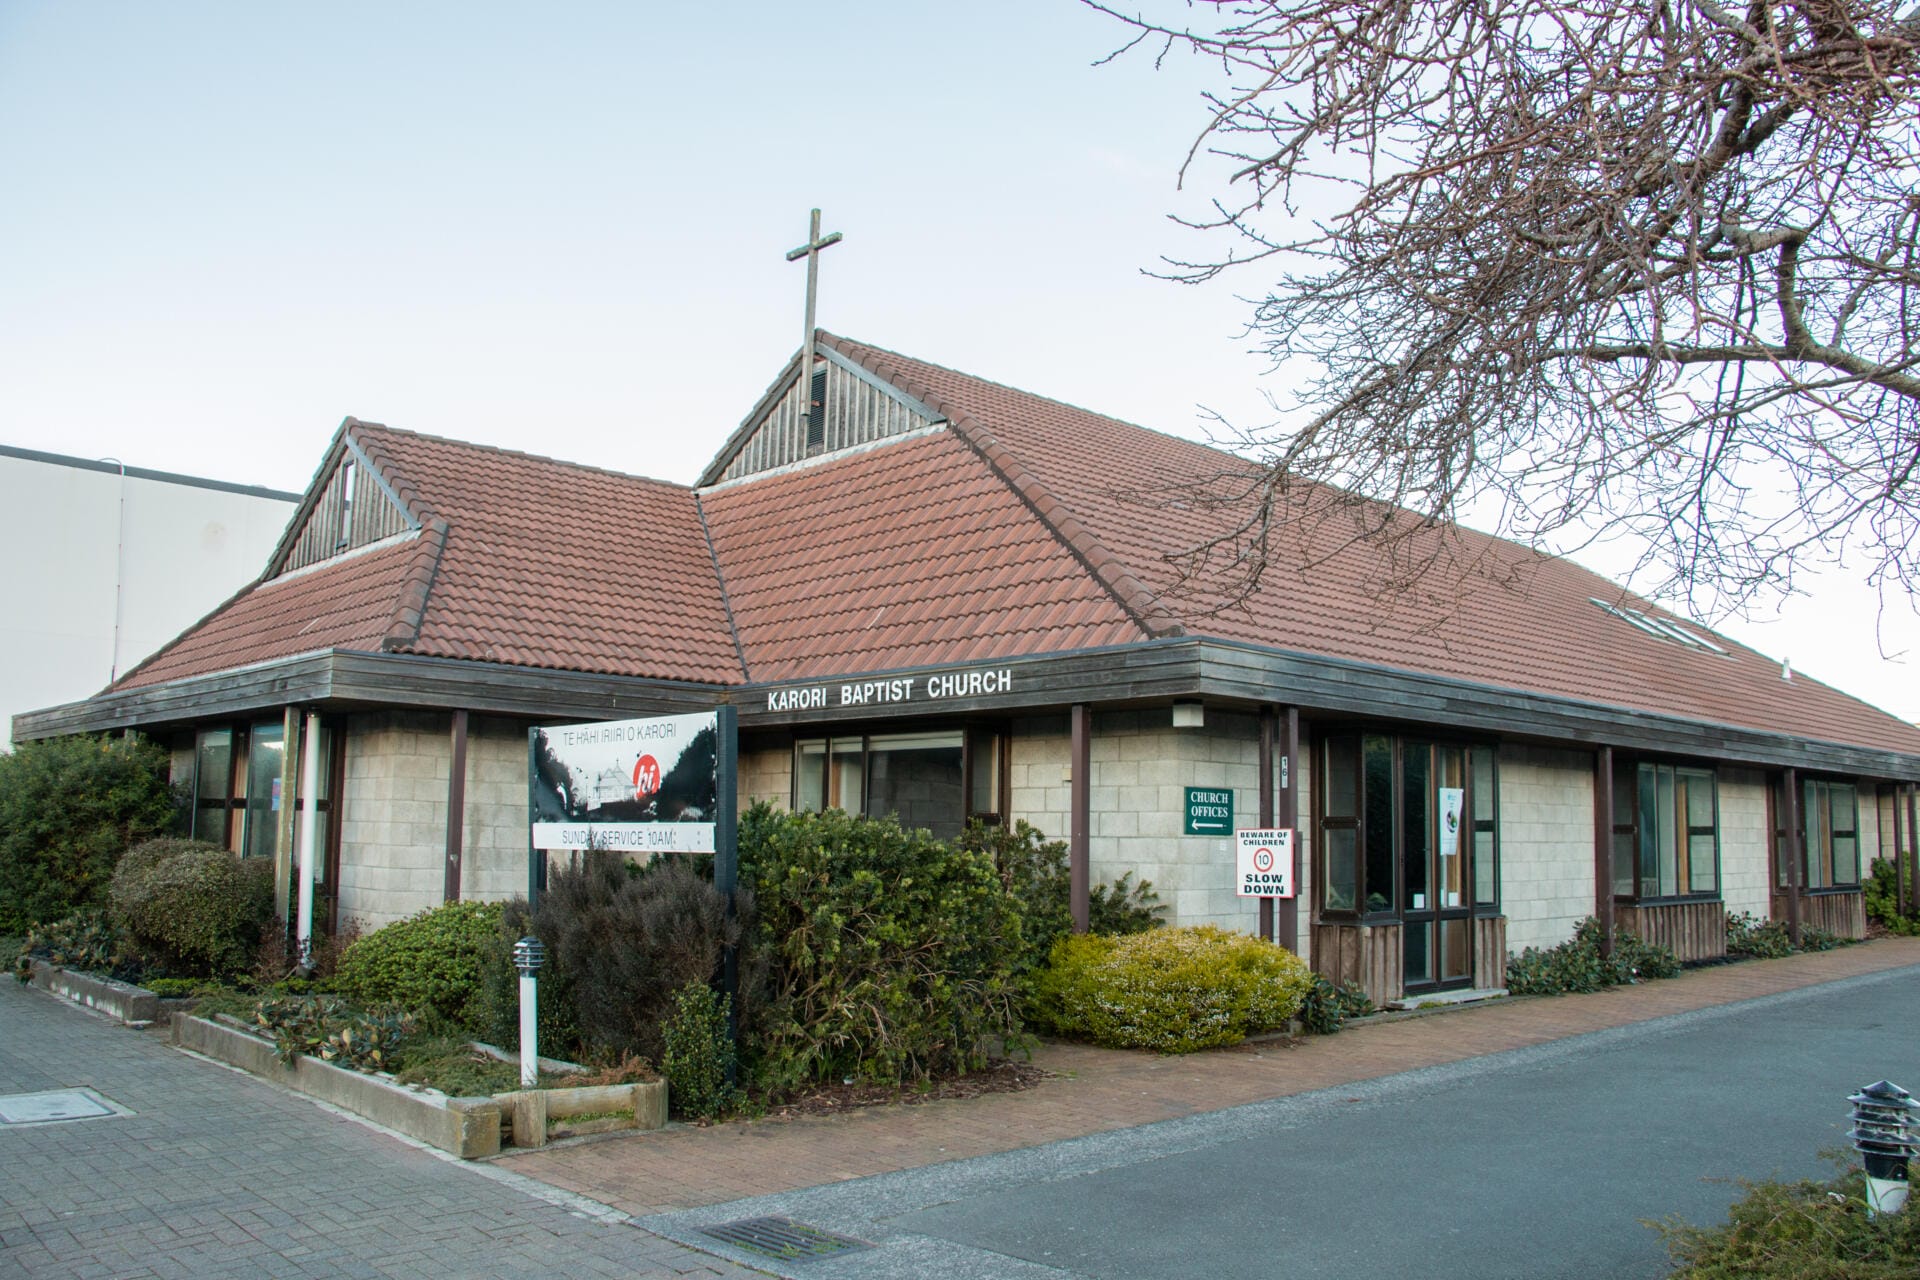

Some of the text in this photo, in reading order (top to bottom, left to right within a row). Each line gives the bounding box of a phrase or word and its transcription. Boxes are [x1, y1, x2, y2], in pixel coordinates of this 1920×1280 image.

[768, 669, 1011, 711] KARORI BAPTIST CHURCH
[563, 732, 574, 746] TE
[627, 726, 634, 741] O
[1190, 791, 1228, 804] CHURCH
[1191, 805, 1228, 818] OFFICES
[602, 830, 643, 845] SERVICE
[648, 830, 673, 846] 10AM
[1240, 831, 1288, 839] BEWARE OF
[1258, 854, 1269, 866] 10
[1245, 873, 1283, 883] SLOW
[1244, 885, 1285, 895] DOWN
